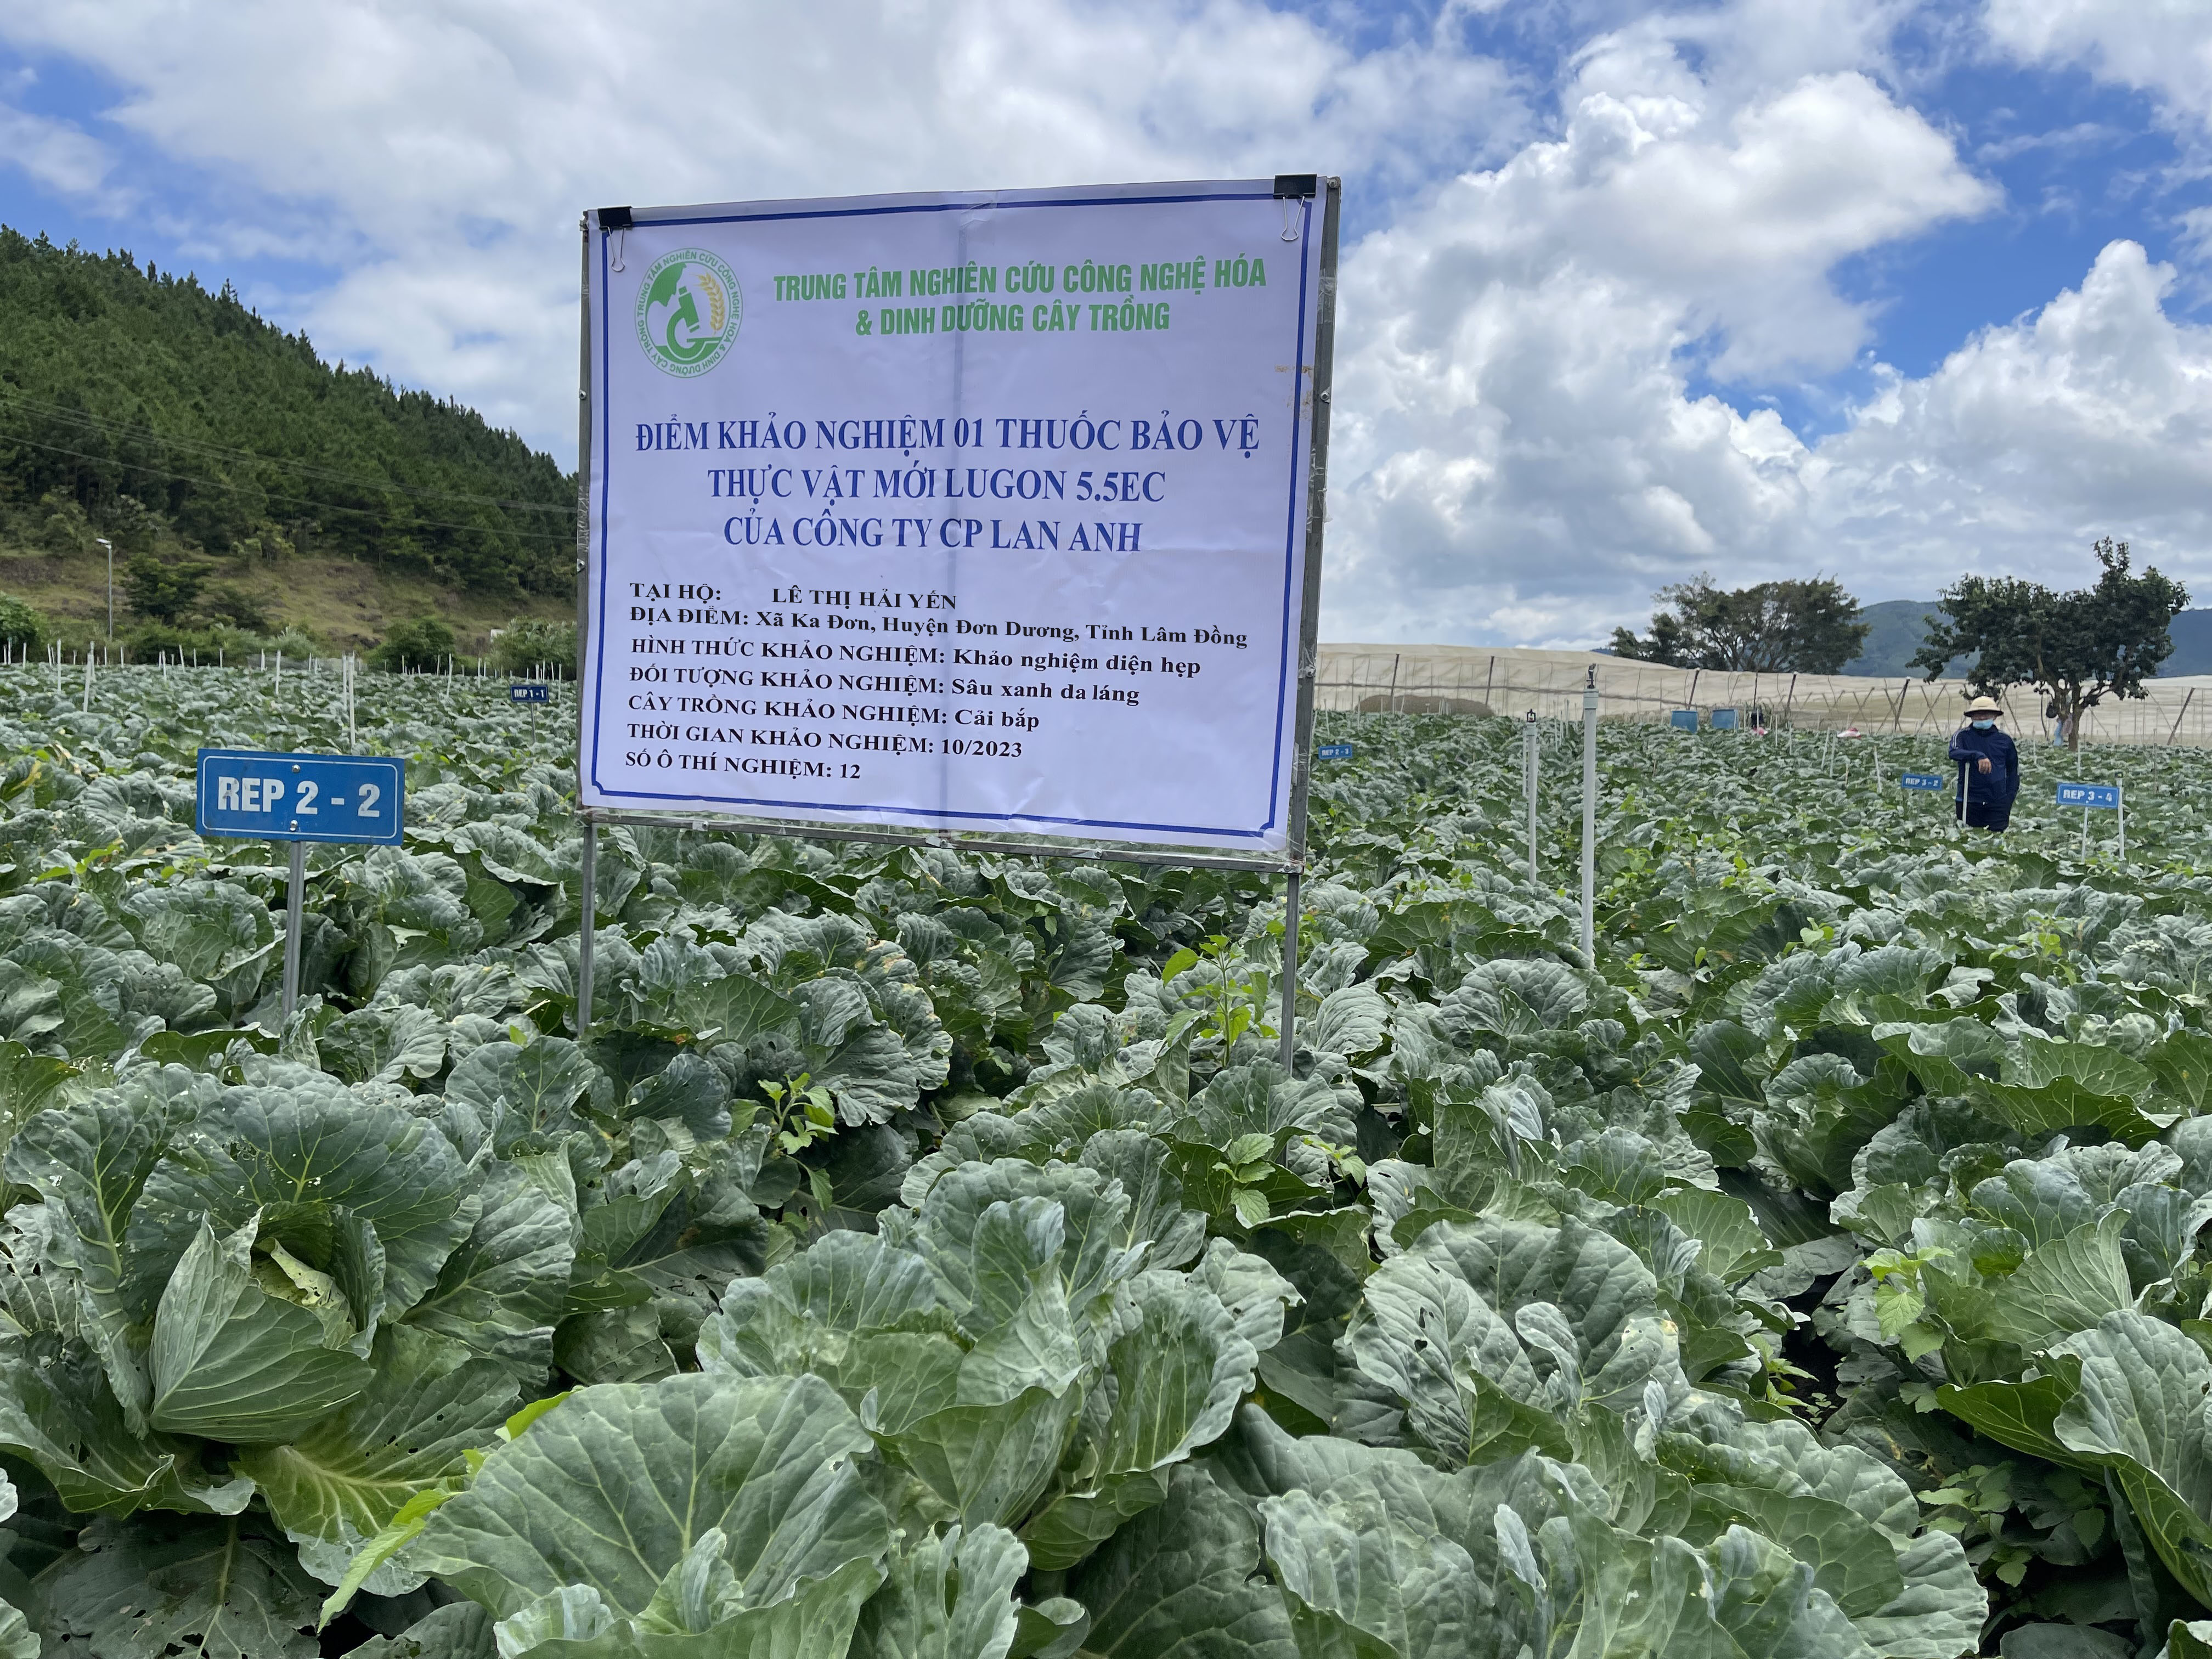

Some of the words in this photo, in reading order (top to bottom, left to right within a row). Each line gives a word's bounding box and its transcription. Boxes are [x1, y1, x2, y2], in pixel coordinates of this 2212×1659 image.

[647, 262, 662, 281] TÂM
[663, 250, 697, 267] NGHIÊN
[699, 253, 719, 268] CỨU
[718, 264, 736, 290] CÔNG
[774, 274, 846, 301] TRUNG
[854, 266, 901, 298] TÂM
[910, 261, 996, 296] NGHIÊN
[1006, 261, 1054, 293] CỨU
[1063, 259, 1131, 292] CÔNG
[1141, 256, 1206, 295] NGHỆ
[1215, 253, 1266, 287] HÓA
[637, 283, 650, 317] TRUNG
[856, 310, 872, 336] &
[881, 307, 935, 334] DINH
[941, 298, 1023, 331] DƯỠNG
[1033, 299, 1081, 331] CÂY
[1088, 294, 1170, 331] TRỒNG
[652, 353, 668, 369] CÂY
[703, 351, 720, 370] DINH
[636, 414, 709, 450] ĐIỂM
[718, 412, 806, 449] KHẢO
[815, 415, 945, 456] NGHIỆM
[955, 418, 984, 447] 01
[996, 410, 1120, 450] THUỐC
[1130, 410, 1202, 450] BẢO
[1212, 414, 1259, 459] VỆ
[708, 464, 792, 505] THỰC
[801, 465, 865, 506] VẬT
[873, 460, 936, 498] MỚI
[944, 469, 1067, 500] LUGON
[1077, 471, 1165, 501] 5.5EC
[724, 508, 785, 545] CỦA
[793, 509, 883, 546] CÔNG
[892, 519, 933, 547] TY
[940, 518, 982, 548] CP
[990, 520, 1060, 550] LAN
[1068, 522, 1143, 551] ANH
[630, 583, 669, 601] TẠI
[678, 584, 720, 603] HỘ:
[772, 585, 802, 603] LÊ
[809, 590, 850, 609] THỊ
[859, 589, 900, 607] HẢI
[907, 590, 957, 609] YẾN
[630, 607, 673, 625] ĐỊA
[678, 606, 748, 625] ĐIỂM:
[755, 612, 784, 627] Xã
[791, 613, 820, 628] Ka
[827, 615, 875, 633] Đơn,
[882, 617, 949, 636] Huyện
[956, 620, 998, 635] Đơn
[1005, 622, 1079, 642] Dương,
[1086, 625, 1133, 640] Tỉnh
[1141, 627, 1186, 642] Lâm
[1194, 625, 1247, 648] Đồng
[632, 635, 685, 654] HÌNH
[692, 637, 753, 656] THỨC
[762, 640, 832, 659] KHẢO
[839, 645, 944, 666] NGHIỆM:
[953, 649, 1012, 665] Khảo
[1021, 653, 1098, 673] nghiệm
[1106, 655, 1152, 675] diện
[1161, 657, 1200, 678] hẹp
[514, 689, 528, 698] REP
[529, 689, 533, 698] 1
[540, 689, 544, 698] 1
[630, 663, 667, 682] ĐỐI
[674, 667, 753, 687] TƯỢNG
[761, 669, 832, 689] KHẢO
[839, 675, 943, 696] NGHIỆM:
[952, 679, 992, 695] Sâu
[1001, 683, 1052, 698] xanh
[1061, 684, 1086, 699] da
[1092, 685, 1139, 706] láng
[629, 691, 673, 710] CÂY
[678, 694, 757, 715] TRỒNG
[764, 699, 834, 719] KHẢO
[842, 705, 946, 726] NGHIỆM:
[955, 709, 993, 725] Cải
[1001, 708, 1039, 732] bắp
[628, 721, 679, 740] THỜI
[686, 726, 743, 743] GIAN
[751, 727, 821, 747] KHẢO
[828, 734, 933, 755] NGHIỆM:
[942, 739, 1021, 757] 10/2023
[626, 748, 651, 766] SỐ
[657, 749, 672, 768] Ô
[679, 752, 716, 770] THÍ
[724, 758, 831, 779] NGHIỆM:
[840, 764, 860, 778] 12
[218, 776, 285, 812] REP
[296, 780, 318, 815] 2
[331, 797, 345, 805] -
[358, 783, 380, 817] 2
[2063, 789, 2085, 799] REP
[2088, 791, 2095, 800] 3
[2106, 792, 2112, 802] 4
